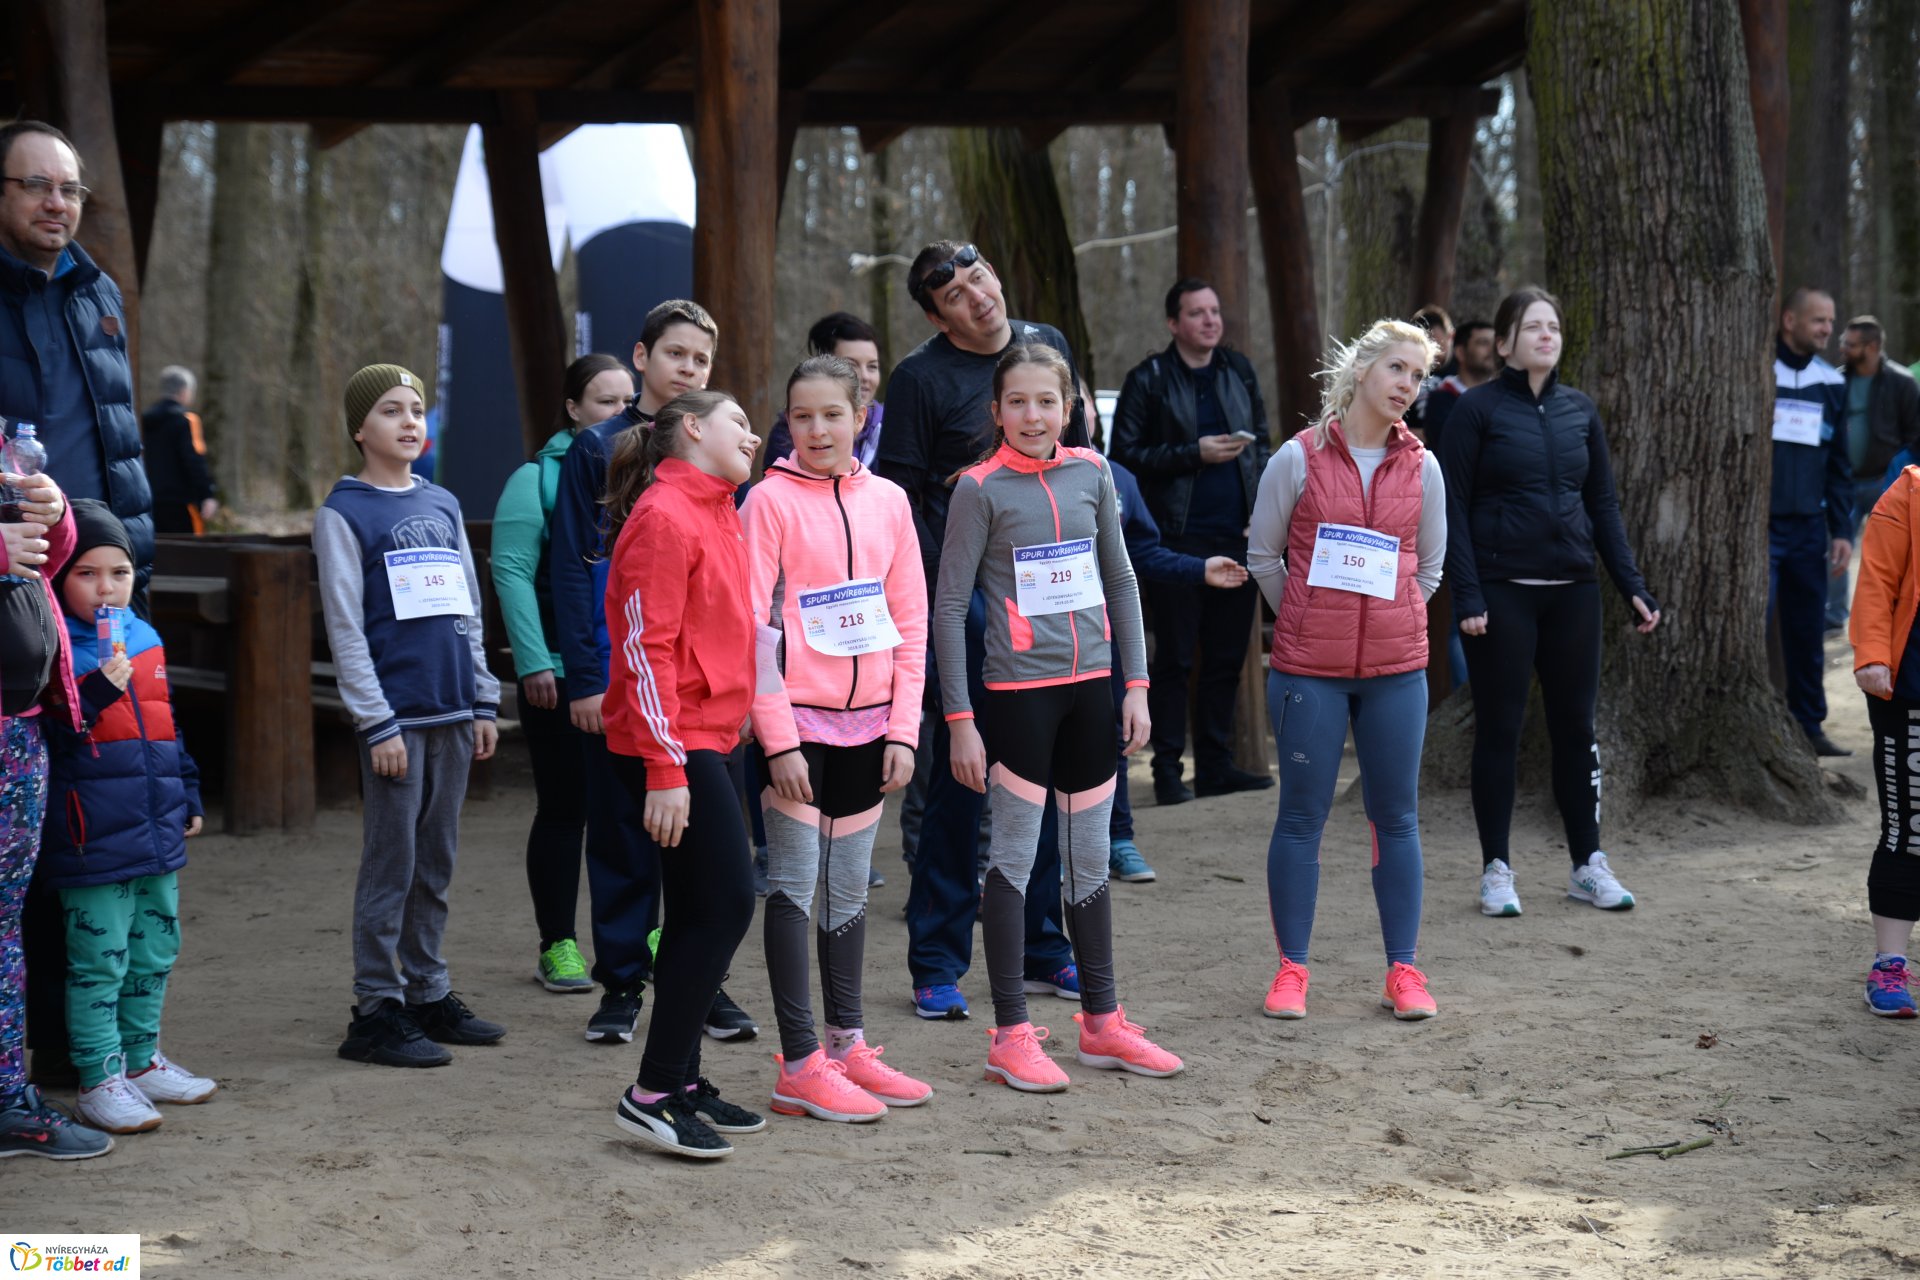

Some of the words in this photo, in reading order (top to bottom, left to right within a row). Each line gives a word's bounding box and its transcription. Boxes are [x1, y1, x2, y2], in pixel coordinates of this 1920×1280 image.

[1323, 530, 1343, 539] SPURI
[1021, 551, 1045, 560] SPURI
[1048, 543, 1089, 557] NYÍREGYHÁZA
[393, 555, 416, 564] SPURI
[1342, 554, 1366, 568] 150
[423, 575, 445, 587] 145
[1050, 569, 1072, 584] 219
[806, 594, 830, 606] SPURI
[834, 585, 879, 600] NYÍREGYHÁZA
[839, 612, 865, 628] 218
